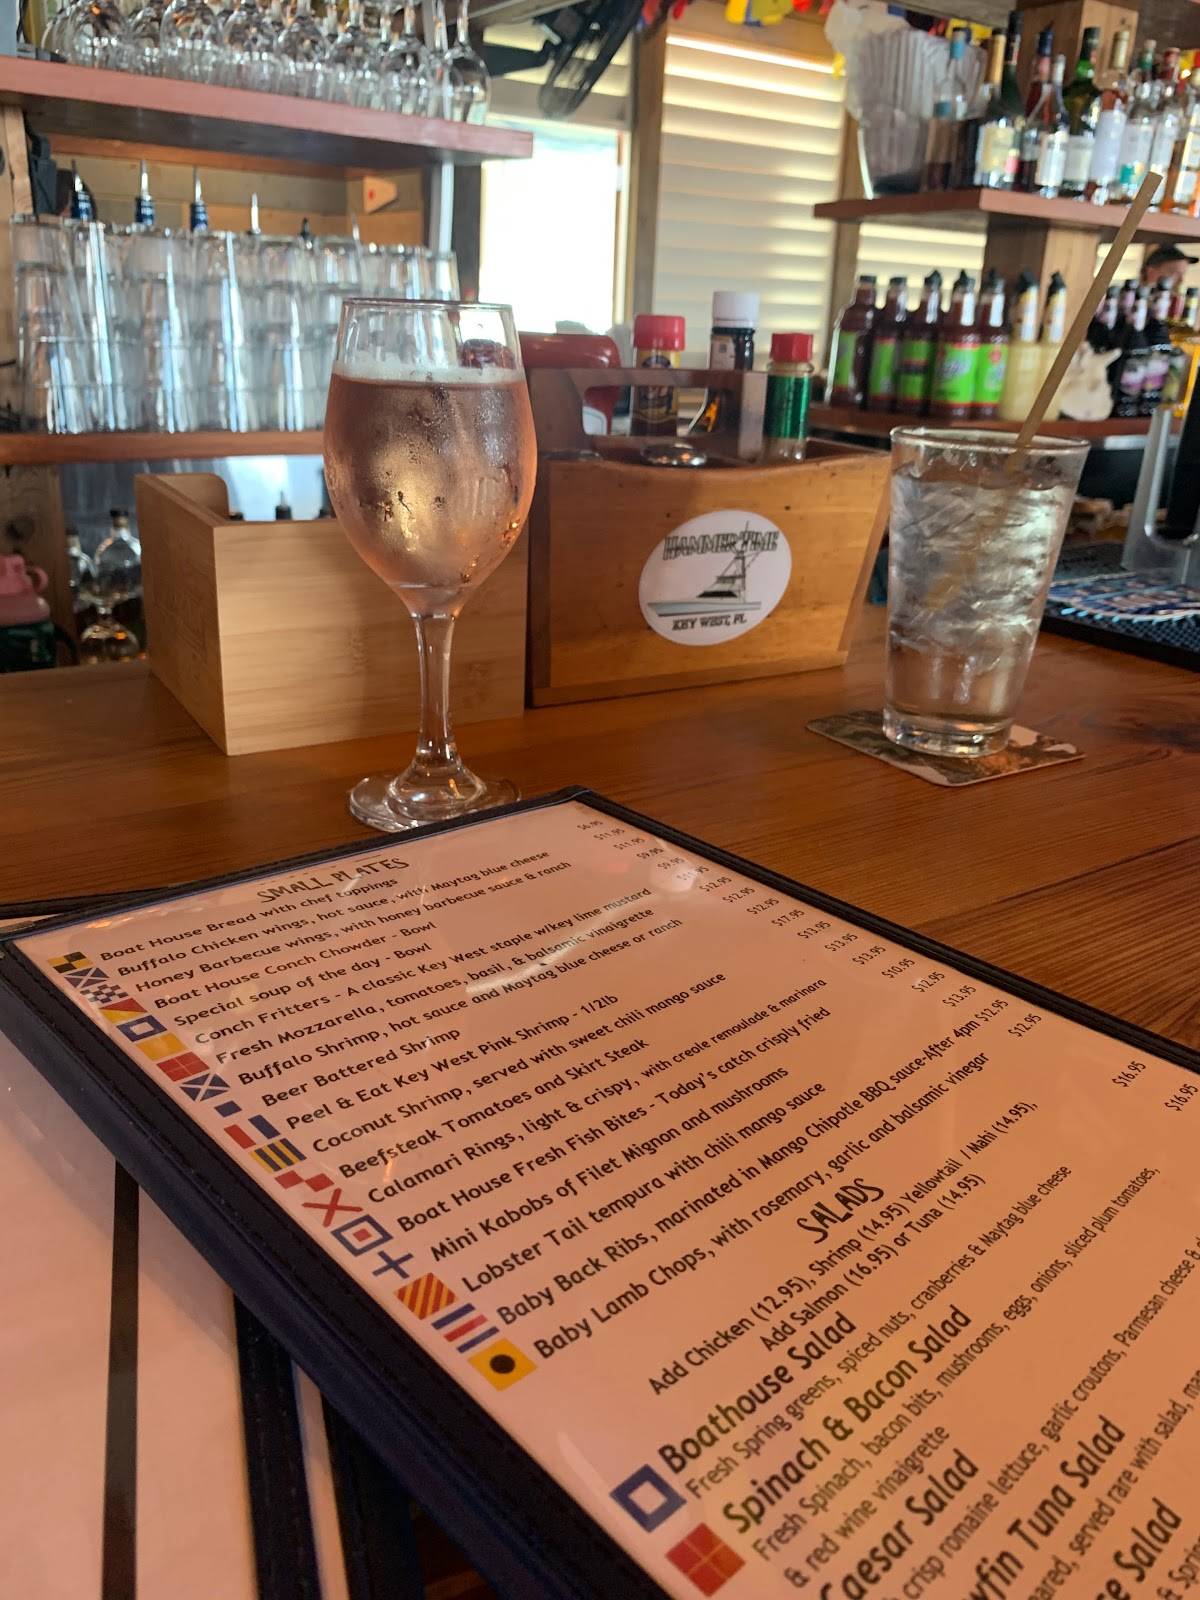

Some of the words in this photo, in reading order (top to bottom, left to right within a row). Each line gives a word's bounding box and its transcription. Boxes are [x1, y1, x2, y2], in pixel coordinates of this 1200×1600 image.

[99, 943, 146, 962] Boat
[147, 928, 203, 948] House
[205, 913, 257, 932] Bread
[258, 904, 297, 918] with
[299, 893, 334, 907] chef
[335, 878, 399, 898] toppings
[256, 876, 335, 904] SMALL
[329, 857, 410, 883] PLATES
[698, 876, 733, 893] $12.95
[721, 887, 756, 904] $12.95
[153, 988, 203, 1009] Boat
[203, 972, 261, 993] House
[264, 955, 317, 975] Conch
[318, 935, 386, 959] Chowder
[398, 921, 438, 937] Bowl
[173, 996, 245, 1027] Special
[248, 984, 292, 1003] soup
[295, 975, 315, 988] of
[317, 968, 348, 981] the
[350, 958, 381, 972] day
[392, 942, 433, 960] Bowl
[851, 945, 887, 965] $13.95
[911, 971, 946, 993] $12.95
[260, 1082, 309, 1107] Beer
[312, 1049, 399, 1088] Battered
[399, 1029, 461, 1056] Shrimp
[746, 897, 780, 915] $12.95
[285, 1103, 334, 1130] Peel
[335, 1096, 355, 1110] &
[355, 1082, 393, 1103] Eat
[392, 1068, 430, 1089] Key
[429, 1050, 479, 1073] West
[477, 1035, 518, 1056] Pink
[514, 1015, 570, 1041] Shrimp
[580, 994, 619, 1015] 1/2lb
[770, 908, 806, 927] $17.95
[312, 1112, 397, 1153] Coconut
[396, 1087, 472, 1119] Shrimp,
[471, 1057, 530, 1089] served
[528, 1044, 568, 1064] with
[568, 1024, 614, 1049] sweet
[613, 1009, 646, 1029] chili
[644, 991, 690, 1015] mango
[689, 973, 727, 995] sauce
[796, 920, 832, 940] $13.95
[338, 1128, 444, 1179] Beefsteak
[440, 1091, 533, 1133] Tomatoes
[534, 1073, 568, 1095] and
[564, 1057, 607, 1081] Skirt
[603, 1039, 651, 1063] Steak
[823, 932, 859, 952] $13.95
[396, 1200, 452, 1233] Boat
[450, 1172, 513, 1207] House
[511, 1146, 568, 1177] Fresh
[564, 1127, 606, 1152] Fish
[602, 1106, 648, 1133] Bites
[653, 1070, 718, 1105] Today’s
[717, 1049, 758, 1074] catch
[755, 1025, 801, 1053] crisply
[796, 1006, 832, 1032] fried
[880, 958, 916, 979] $10.95
[460, 1241, 543, 1293] Lobster
[542, 1216, 590, 1247] Tail
[587, 1177, 667, 1224] tempura
[663, 1154, 705, 1181] with
[703, 1132, 740, 1159] chili
[736, 1107, 788, 1140] mango
[785, 1083, 827, 1111] sauce
[941, 984, 977, 1008] $13.95
[959, 1149, 972, 1161] /
[965, 1129, 998, 1155] Mahi
[991, 1101, 1039, 1135] (14.95),
[495, 1286, 555, 1326] Baby
[552, 1256, 609, 1293] Back
[602, 1232, 659, 1263] Ribs,
[653, 1173, 744, 1234] marinated
[736, 1166, 762, 1181] in
[756, 1135, 809, 1170] Mango
[804, 1099, 865, 1138] Chipotle
[858, 1080, 897, 1103] BBQ
[889, 1036, 956, 1084] sauce-After
[951, 1020, 982, 1038] 4pm
[973, 999, 1009, 1022] $12.95
[532, 1317, 593, 1360] Baby
[589, 1282, 650, 1324] Lamb
[647, 1247, 716, 1286] Chops,
[709, 1217, 754, 1248] with
[751, 1170, 833, 1223] rosemary,
[827, 1139, 871, 1174] garlic
[867, 1118, 897, 1143] and
[888, 1083, 950, 1126] balsamic
[943, 1052, 990, 1085] vinegar
[1007, 1012, 1042, 1038] $12.95
[898, 1157, 964, 1204] Yellowtail
[796, 1177, 885, 1245] SALADS
[856, 1201, 911, 1242] (14.95)
[656, 1364, 795, 1475] Boathouse
[786, 1309, 858, 1371] Salad
[1111, 1060, 1147, 1088] $16.95
[749, 1275, 817, 1322] (12.95),
[759, 1319, 797, 1353] Add
[789, 1283, 849, 1327] Salmon
[842, 1243, 900, 1287] (16.95)
[893, 1231, 912, 1248] or
[903, 1207, 945, 1234] Tuna
[936, 1173, 987, 1211] (14.95)
[808, 1238, 863, 1277] Shrimp
[684, 1456, 740, 1500] Fresh
[732, 1413, 793, 1460] Spring
[784, 1374, 844, 1422] greens,
[836, 1331, 884, 1375] spiced
[877, 1311, 917, 1339] nuts,
[910, 1253, 976, 1311] cranberries
[967, 1243, 987, 1256] &
[977, 1212, 1025, 1248] Maytag
[1010, 1193, 1043, 1216] blue
[1036, 1166, 1072, 1196] cheese
[684, 1317, 756, 1367] Chicken
[722, 1436, 832, 1535] Spinach
[822, 1415, 855, 1442] &
[842, 1359, 919, 1424] Bacon
[907, 1303, 973, 1365] Salad
[1163, 1083, 1199, 1112] $16.95
[647, 1359, 690, 1396] Add
[938, 1492, 1000, 1559] romaine
[986, 1442, 1050, 1496] lettuce,
[1039, 1399, 1080, 1444] garlic
[1071, 1348, 1128, 1403] croutons,
[1112, 1293, 1168, 1348] Parmesan
[1158, 1259, 1196, 1296] cheese
[783, 1566, 811, 1589] &
[805, 1532, 841, 1573] red
[834, 1499, 878, 1540] wine
[871, 1426, 950, 1501] vinaigrette
[904, 1447, 980, 1527] Salad
[1005, 1483, 1077, 1552] Tuna
[1059, 1414, 1126, 1490] Salad
[1068, 1497, 1116, 1557] served
[1106, 1469, 1139, 1505] rare
[1129, 1436, 1163, 1471] with
[1153, 1398, 1194, 1441] salad,
[1112, 1496, 1183, 1584] Salad
